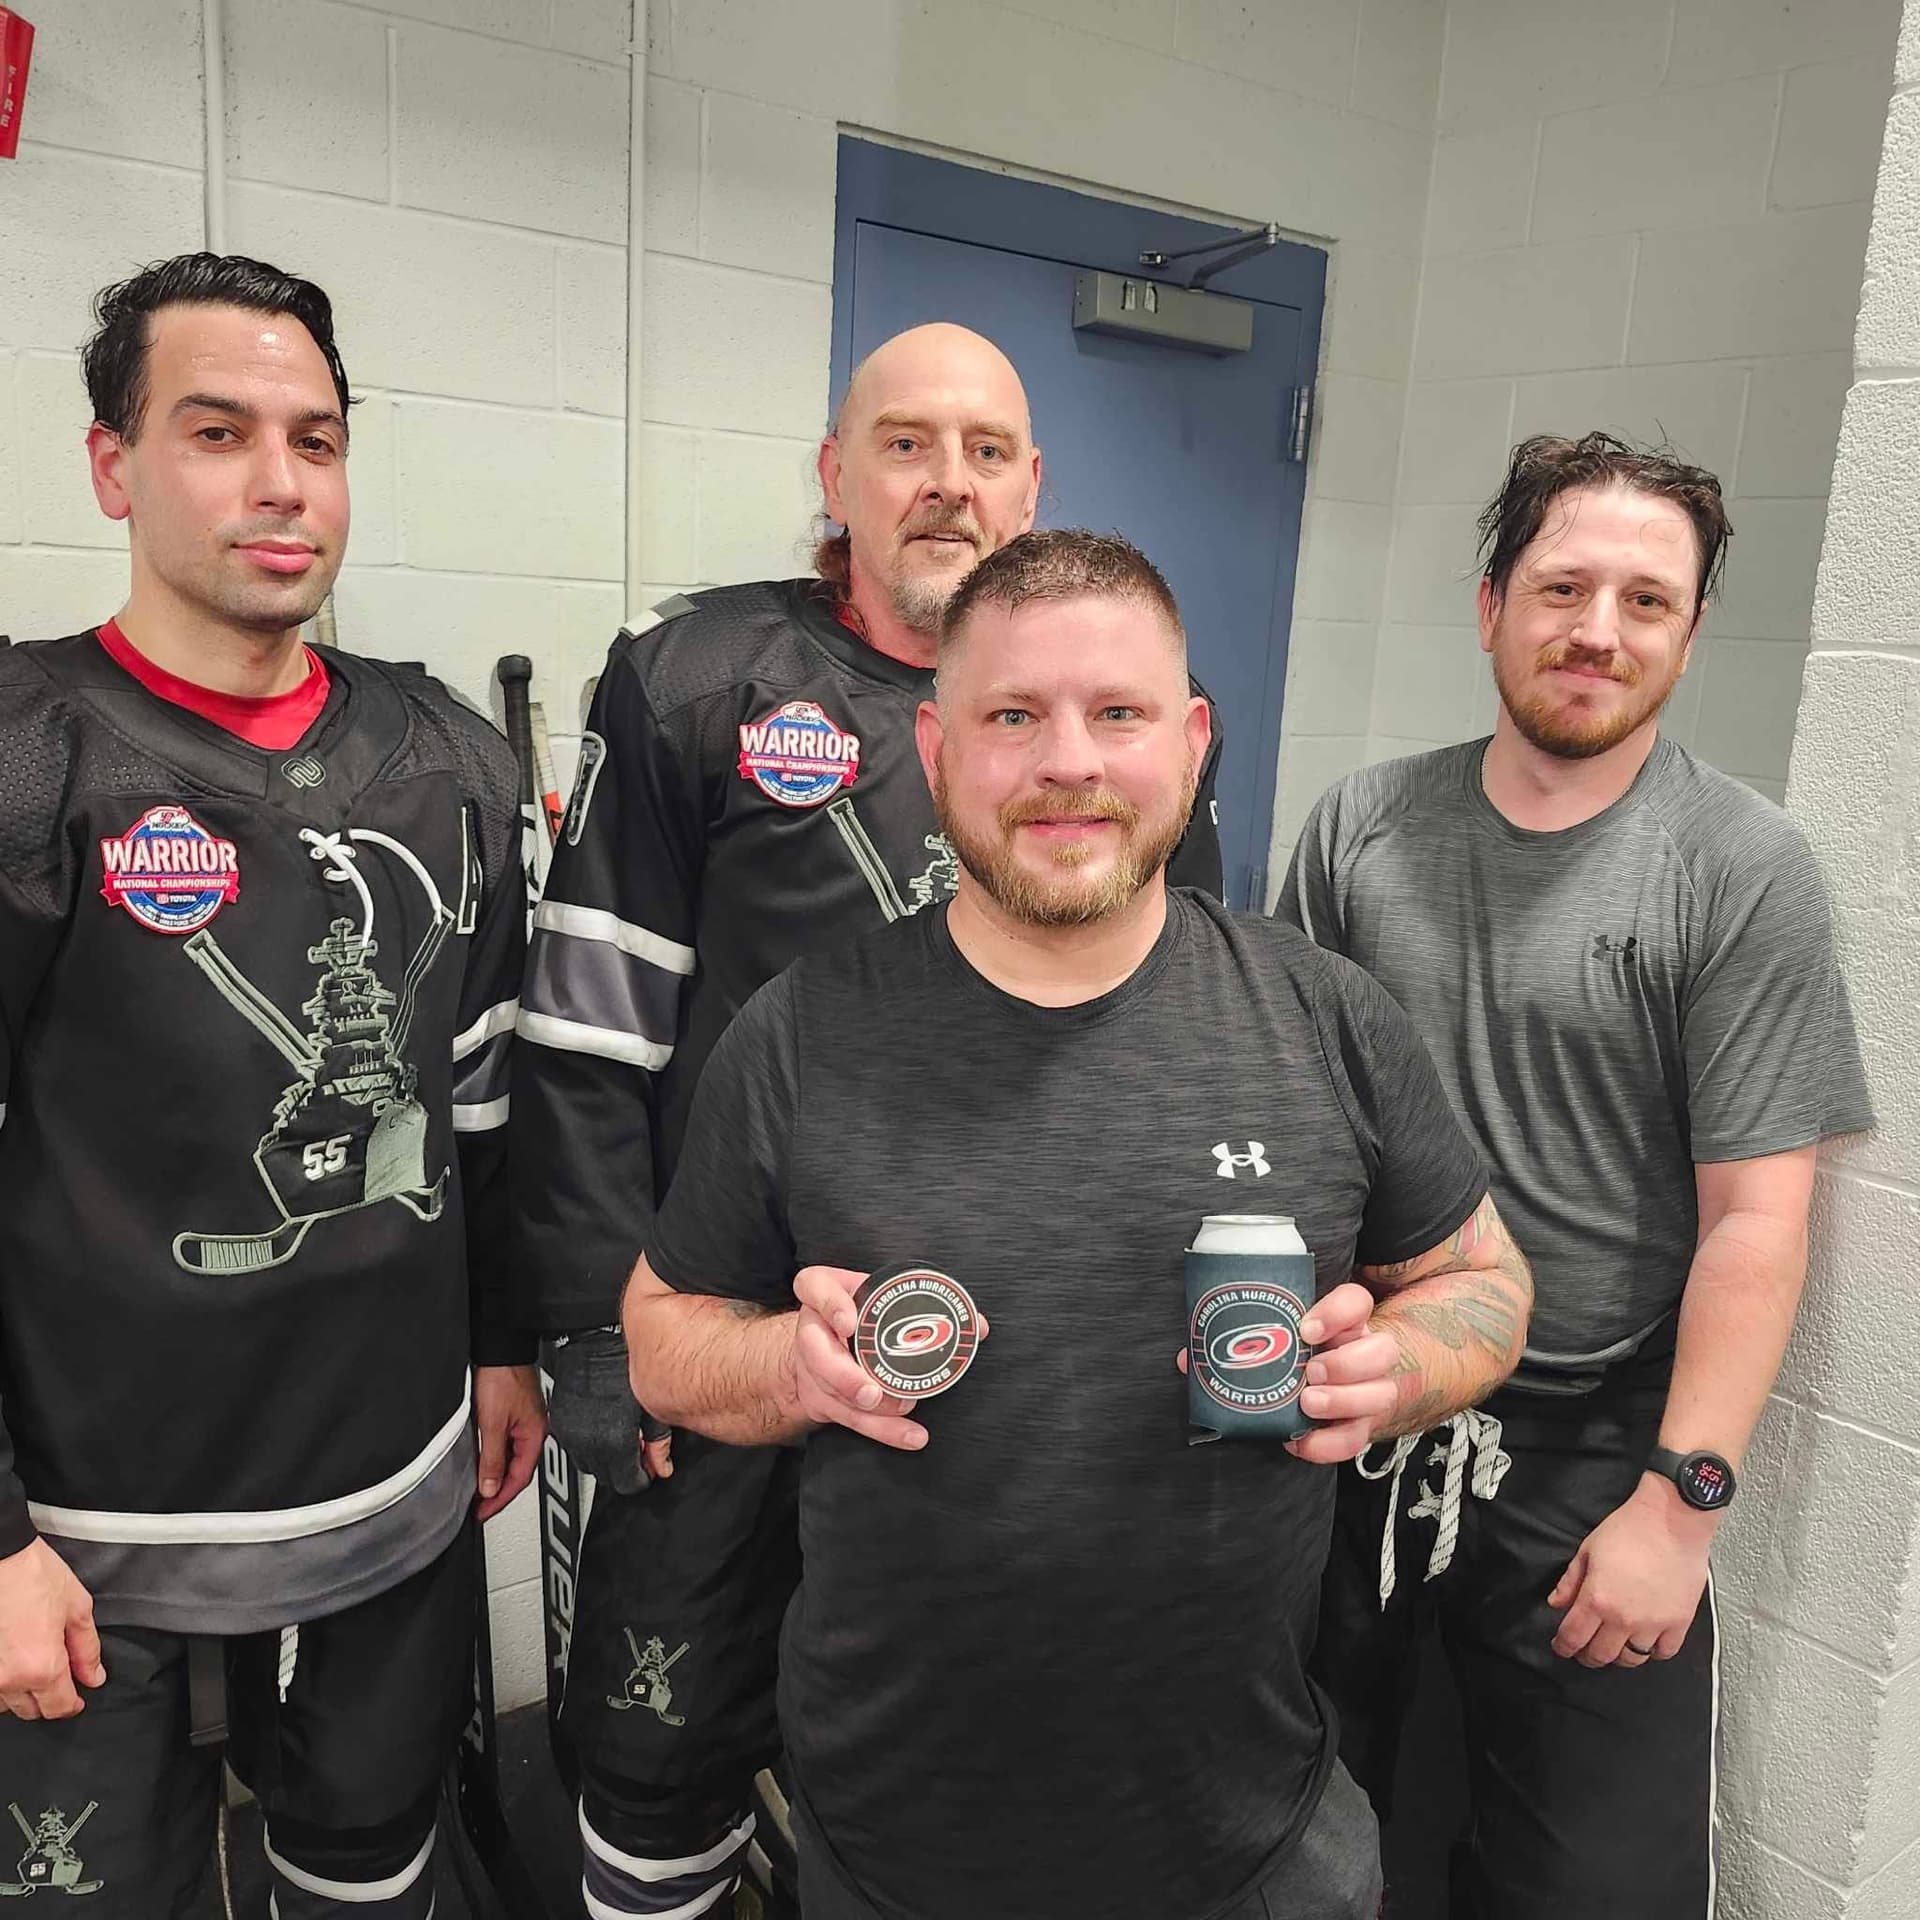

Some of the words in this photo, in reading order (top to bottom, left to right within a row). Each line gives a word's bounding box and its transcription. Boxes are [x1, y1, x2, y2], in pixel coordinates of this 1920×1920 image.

[1, 64, 17, 128] FIRE
[740, 725, 860, 762] WARRIOR
[746, 758, 785, 768] NATIONAL
[786, 760, 849, 774] CHAMPIONSHIPS
[102, 838, 239, 873] WARRIOR
[113, 879, 159, 890] NATIONAL
[161, 878, 231, 889] CHAMPIONSHIPS
[169, 895, 197, 903] TOYOTA
[303, 1134, 353, 1181] 55
[871, 1280, 917, 1316] CAROLINA
[919, 1279, 970, 1322] HURRICANES
[1198, 1291, 1238, 1328] CAROLINA
[1241, 1290, 1301, 1328] HURRICANE
[874, 1363, 952, 1391] WARRIORS
[1208, 1376, 1299, 1405] WARRIORS
[540, 1367, 573, 1670] AUER
[30, 1862, 46, 1877] 55
